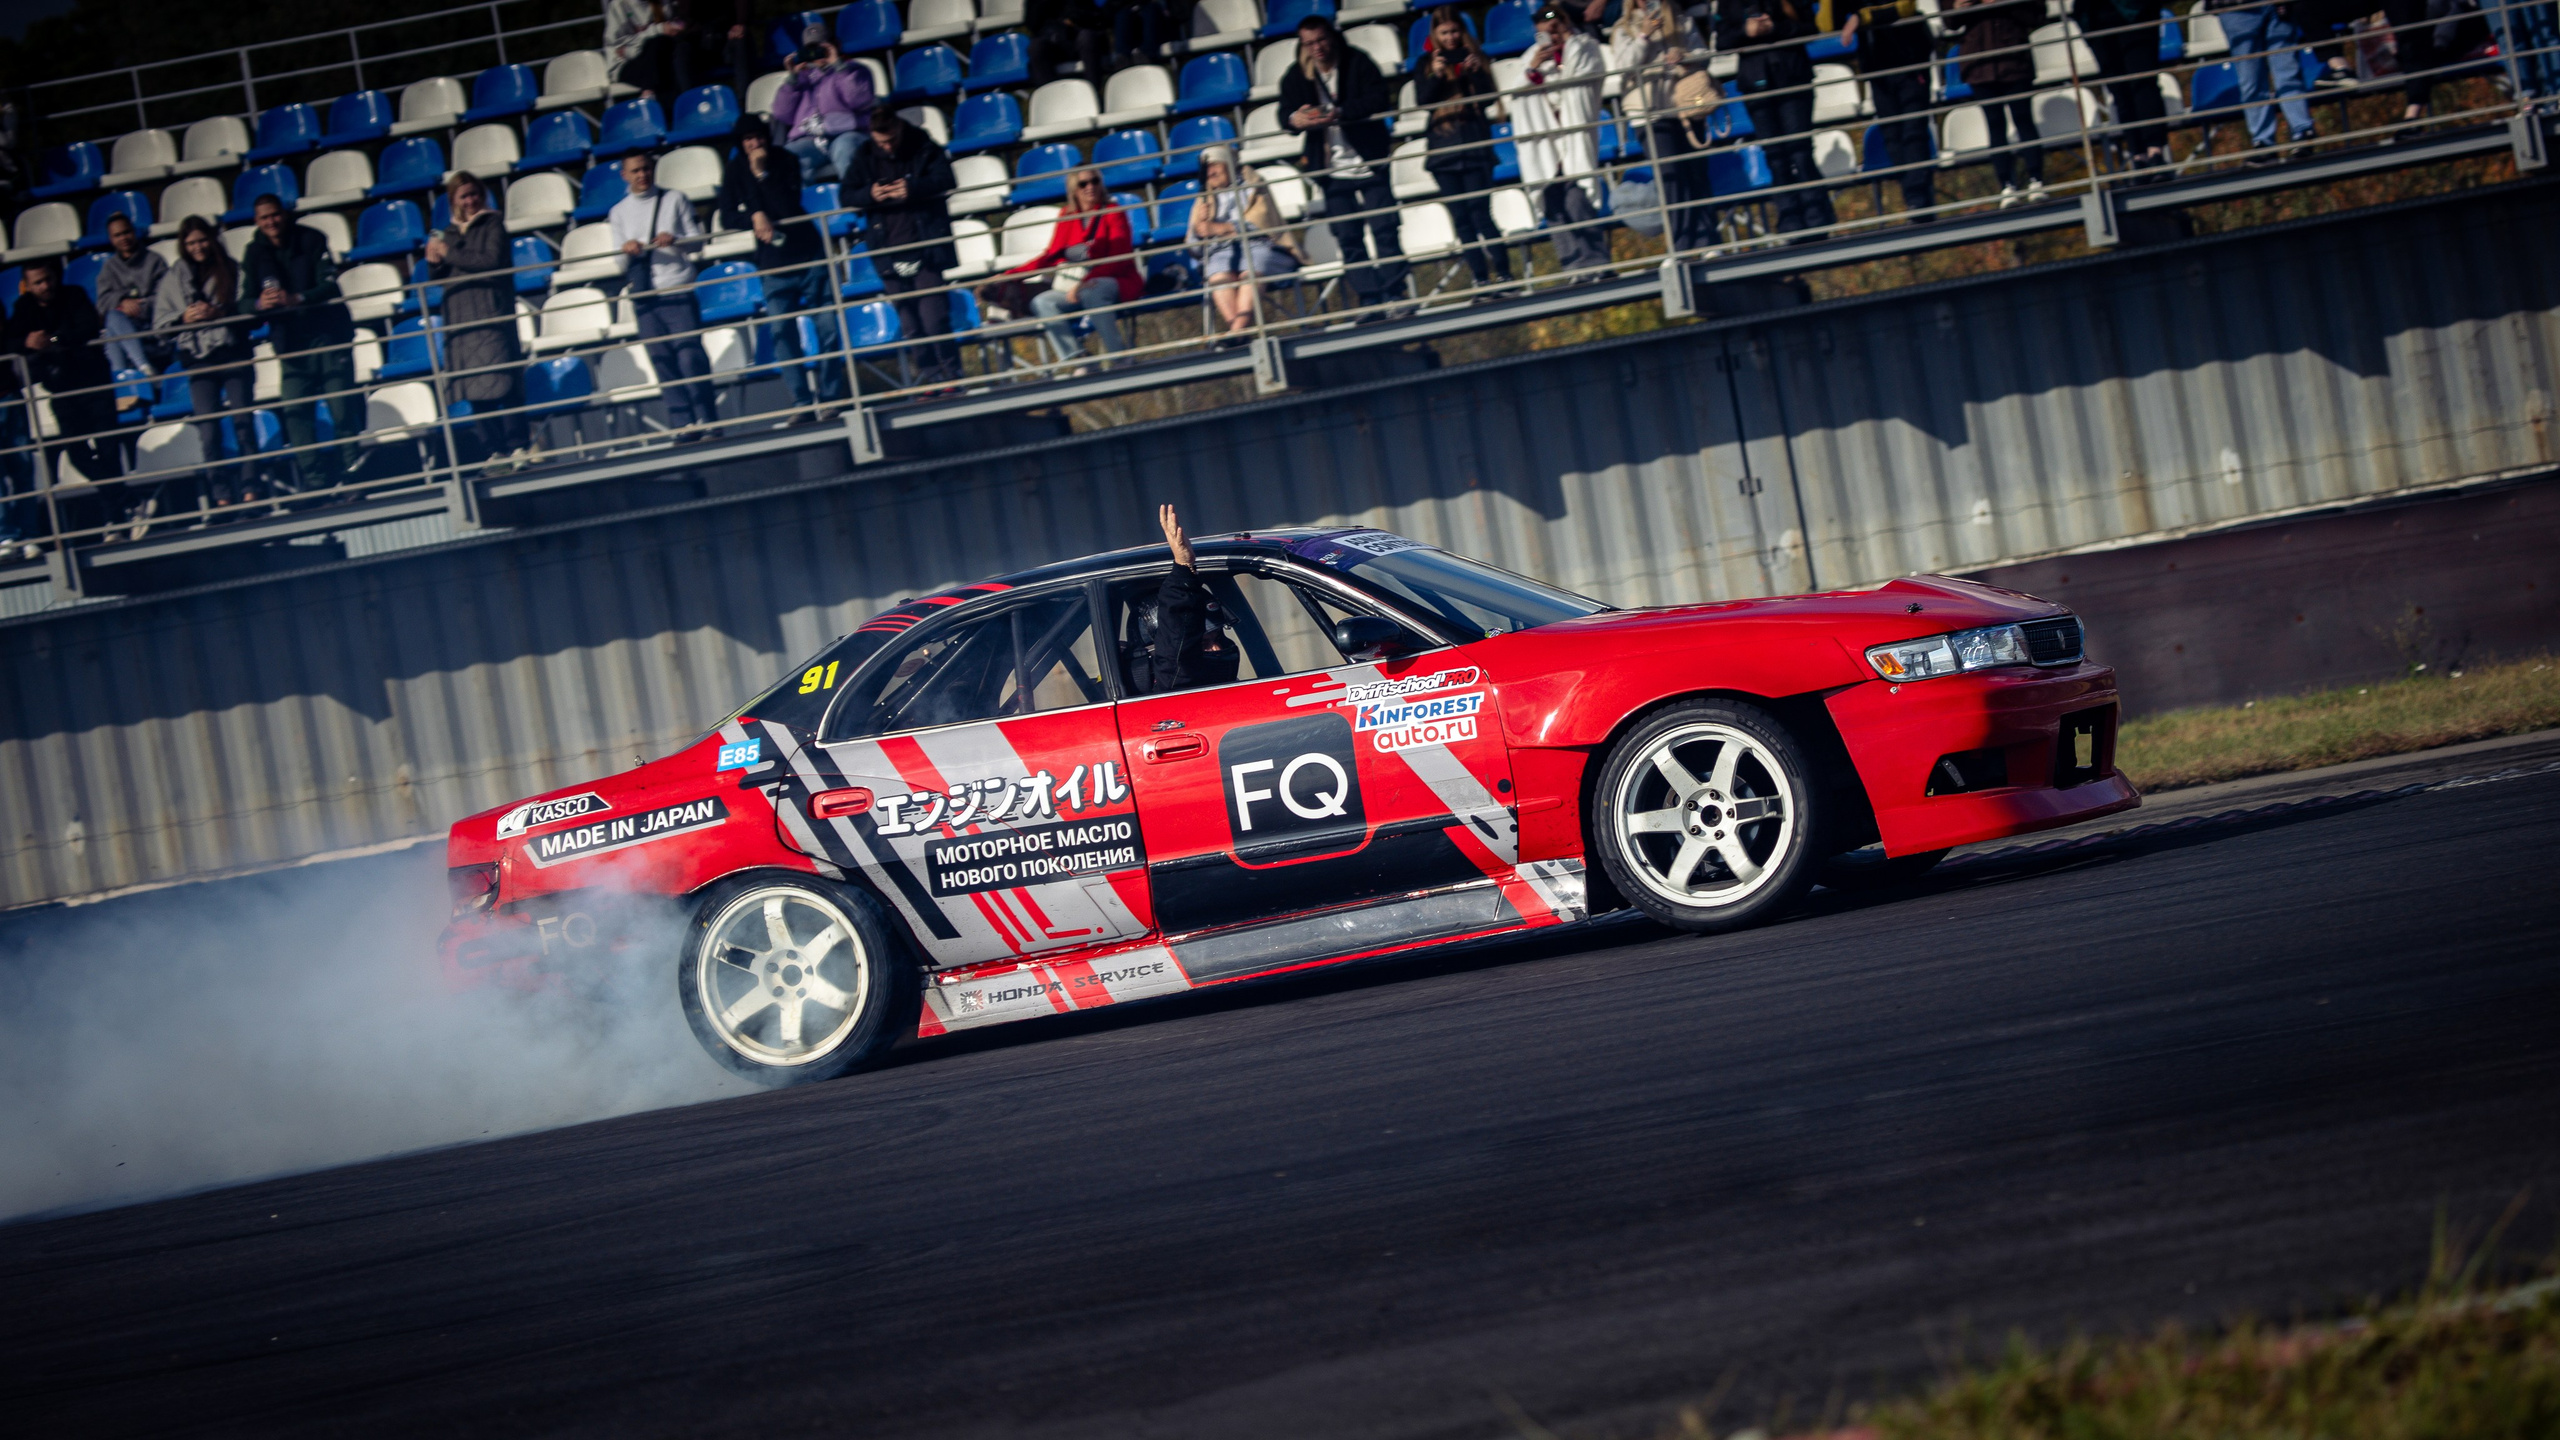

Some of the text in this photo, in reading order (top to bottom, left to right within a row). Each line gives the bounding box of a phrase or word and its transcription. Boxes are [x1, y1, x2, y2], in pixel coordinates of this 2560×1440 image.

[798, 660, 840, 695] 91
[719, 744, 759, 767] E85
[1377, 719, 1474, 750] auto.ru
[531, 797, 590, 824] KASCO
[876, 760, 1127, 836] エンジンオイル
[1230, 752, 1349, 832] FQ
[541, 799, 714, 858] MADE IN JAPAN
[935, 821, 1132, 866] МОТОРНОЕ МАСЛО
[940, 846, 1136, 889] НОВОГО ПОКОЛЕНИЯ
[537, 912, 597, 955] FQ
[988, 961, 1165, 1005] HONDA SERVICE
